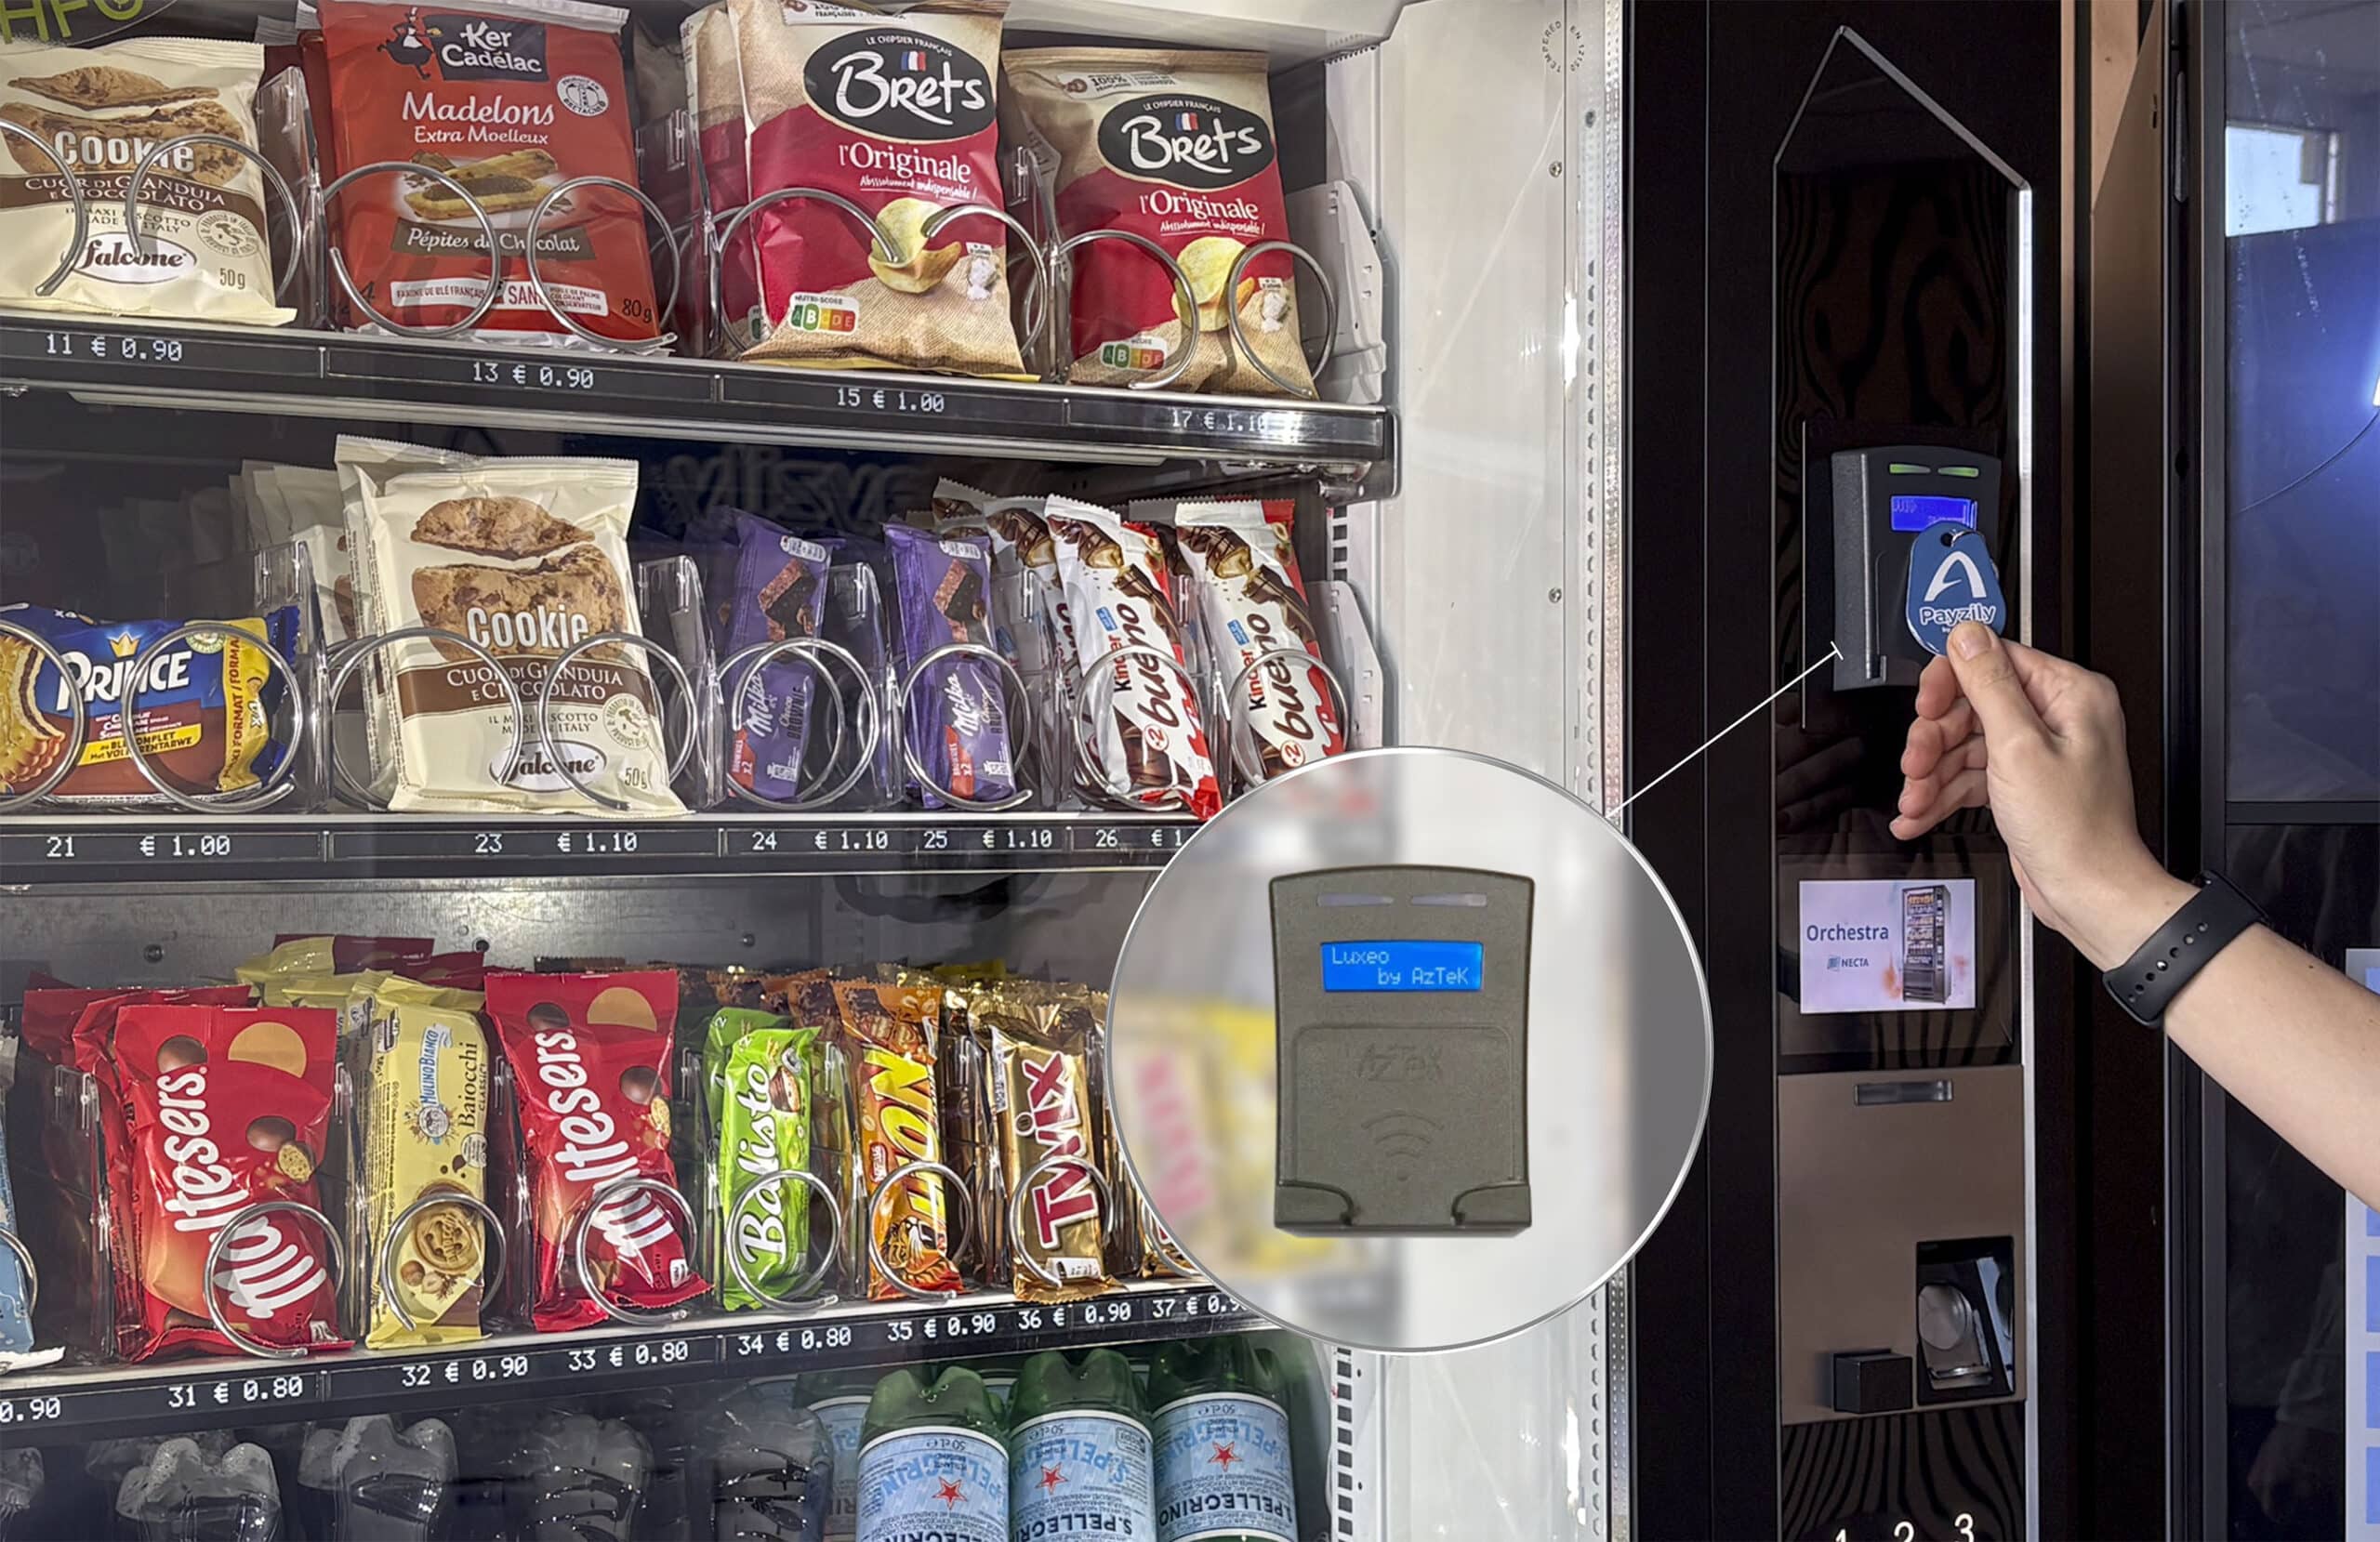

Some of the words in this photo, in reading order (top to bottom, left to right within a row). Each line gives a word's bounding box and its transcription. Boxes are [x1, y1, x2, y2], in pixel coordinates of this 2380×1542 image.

[460, 21, 512, 50] Ker
[866, 36, 875, 46] LE
[877, 34, 914, 46] CHIPSIER
[915, 38, 953, 57] FRANÇAIS
[442, 44, 543, 73] Cadélac
[831, 51, 986, 125] Brets
[403, 91, 555, 125] Madelons
[1144, 103, 1152, 112] LE
[1185, 100, 1223, 113] FRANÇAIS
[415, 125, 463, 143] Extra
[468, 125, 549, 145] Moelleux
[1121, 115, 1262, 174] Brets
[839, 141, 972, 183] l'Originale
[115, 175, 225, 206] GANDUIA
[1140, 190, 1260, 220] l'Originale
[82, 239, 186, 270] falcone
[406, 228, 469, 252] Pépites
[499, 231, 581, 253] Chcolat
[46, 333, 73, 356] 11
[91, 336, 106, 358] €
[122, 337, 182, 362] 0.90
[473, 362, 498, 383] 13
[512, 364, 526, 384] €
[539, 366, 594, 389] 0.90
[837, 388, 861, 406] 15
[872, 389, 884, 409] €
[898, 393, 945, 412] 1.00
[1172, 408, 1192, 428] 17
[467, 604, 589, 649] Cookie
[1919, 601, 1997, 626] Payzily
[229, 636, 241, 684] FORMA
[1117, 603, 1180, 728] bueno
[56, 651, 192, 712] PRINCE
[447, 666, 502, 687] CUO
[527, 662, 623, 687] GINDUIA
[1247, 613, 1314, 741] bueno
[482, 680, 606, 701] CICCOLATO
[744, 671, 774, 738] Milka
[503, 714, 533, 724] MXI
[549, 713, 599, 723] SCOTTO
[945, 673, 979, 737] Milka
[137, 731, 176, 745] OMPLET
[502, 725, 536, 735] MDE
[507, 750, 597, 782] falcne
[46, 836, 75, 858] 21
[139, 837, 155, 857] €
[172, 835, 231, 857] 1.00
[475, 833, 503, 853] 23
[557, 834, 571, 852] €
[586, 832, 638, 852] 1.10
[751, 832, 777, 850] 24
[814, 832, 827, 850] €
[840, 831, 888, 850] 1.10
[923, 831, 948, 850] 25
[982, 830, 995, 848] €
[1007, 830, 1052, 848] 1.10
[1095, 829, 1118, 848] 26
[1151, 829, 1163, 847] €
[1806, 923, 1889, 942] Orchestra
[1331, 945, 1391, 965] Luxeo
[1841, 957, 1869, 969] NECTA
[1377, 967, 1401, 985] by
[1411, 967, 1470, 985] AzTeK
[457, 1041, 478, 1128] Baiocchi
[736, 1062, 787, 1266] Balisto
[156, 1071, 327, 1319] Maltesers
[1018, 1311, 1041, 1329] 36
[1052, 1307, 1065, 1327] €
[1084, 1301, 1131, 1325] 0.90
[1152, 1298, 1176, 1318] 37
[1185, 1296, 1198, 1316] €
[1207, 1294, 1247, 1313] 0.9
[737, 1335, 763, 1356] 34
[775, 1332, 789, 1352] €
[800, 1326, 852, 1350] 0.80
[887, 1321, 913, 1341] 35
[923, 1318, 937, 1339] €
[947, 1313, 996, 1336] 0.90
[568, 1349, 596, 1372] 33
[609, 1346, 624, 1368] €
[635, 1340, 689, 1365] 0.80
[402, 1364, 430, 1387] 32
[444, 1362, 459, 1383] €
[472, 1355, 529, 1380] 0.90
[168, 1385, 196, 1408] 31
[213, 1382, 230, 1404] €
[243, 1376, 304, 1402] 0.80
[0, 1396, 61, 1423] 0.90
[1954, 1513, 1975, 1542] 3
